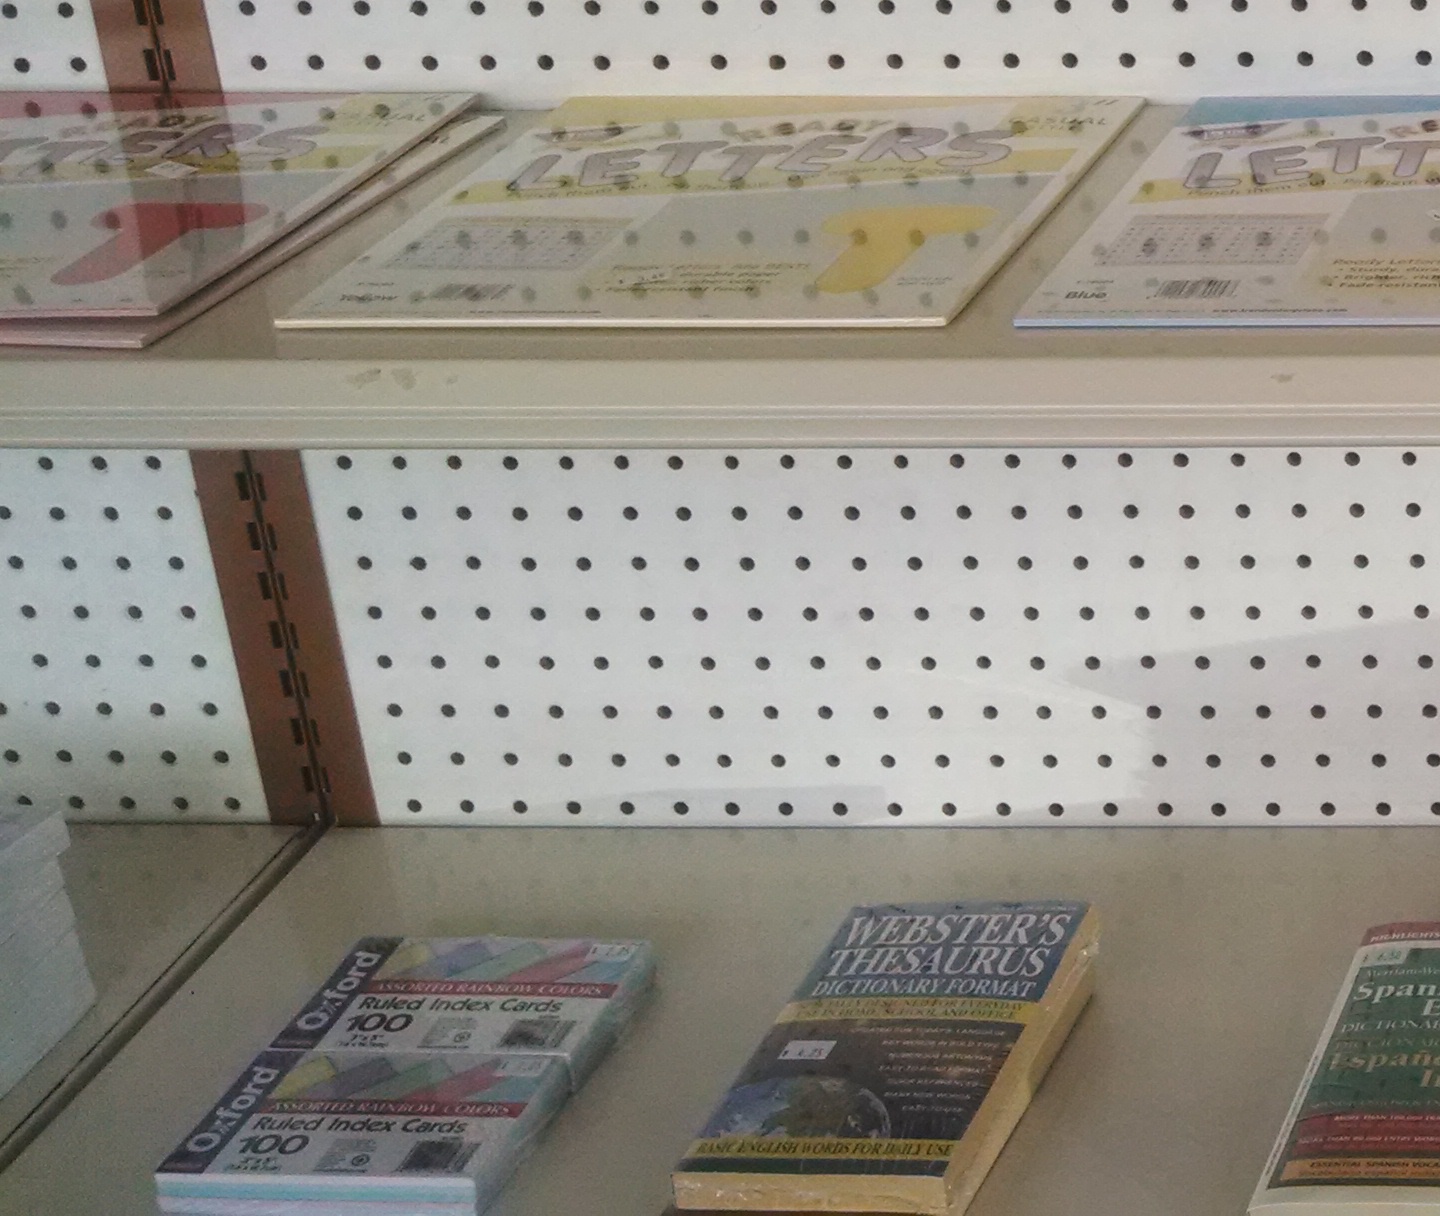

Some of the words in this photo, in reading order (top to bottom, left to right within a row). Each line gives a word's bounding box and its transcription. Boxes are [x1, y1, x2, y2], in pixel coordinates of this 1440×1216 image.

[506, 126, 1016, 192] LETTERS
[1064, 290, 1108, 300] Blue
[844, 913, 1073, 946] WEBSTER'S
[1370, 931, 1440, 943] HIGHLIGHTS
[826, 947, 1051, 977] THESAURUS
[295, 949, 382, 1032] Oxford
[453, 983, 535, 996] RAINBOW
[811, 980, 943, 997] DICTIONARY
[947, 981, 1037, 998] FORMAT
[357, 995, 426, 1014] Ruled
[429, 996, 495, 1013] Index
[499, 996, 563, 1014] Cards
[344, 1014, 414, 1033] 100
[186, 1065, 281, 1153] Oxford
[357, 1101, 440, 1115] RAINBOW
[252, 1115, 324, 1132] Ruled
[327, 1115, 397, 1133] Index
[401, 1117, 469, 1134] Cards
[237, 1134, 311, 1155] 100
[739, 1142, 798, 1156] ENGLISH
[801, 1142, 851, 1156] WORDS
[854, 1142, 883, 1156] FOR
[926, 1143, 955, 1157] USE
